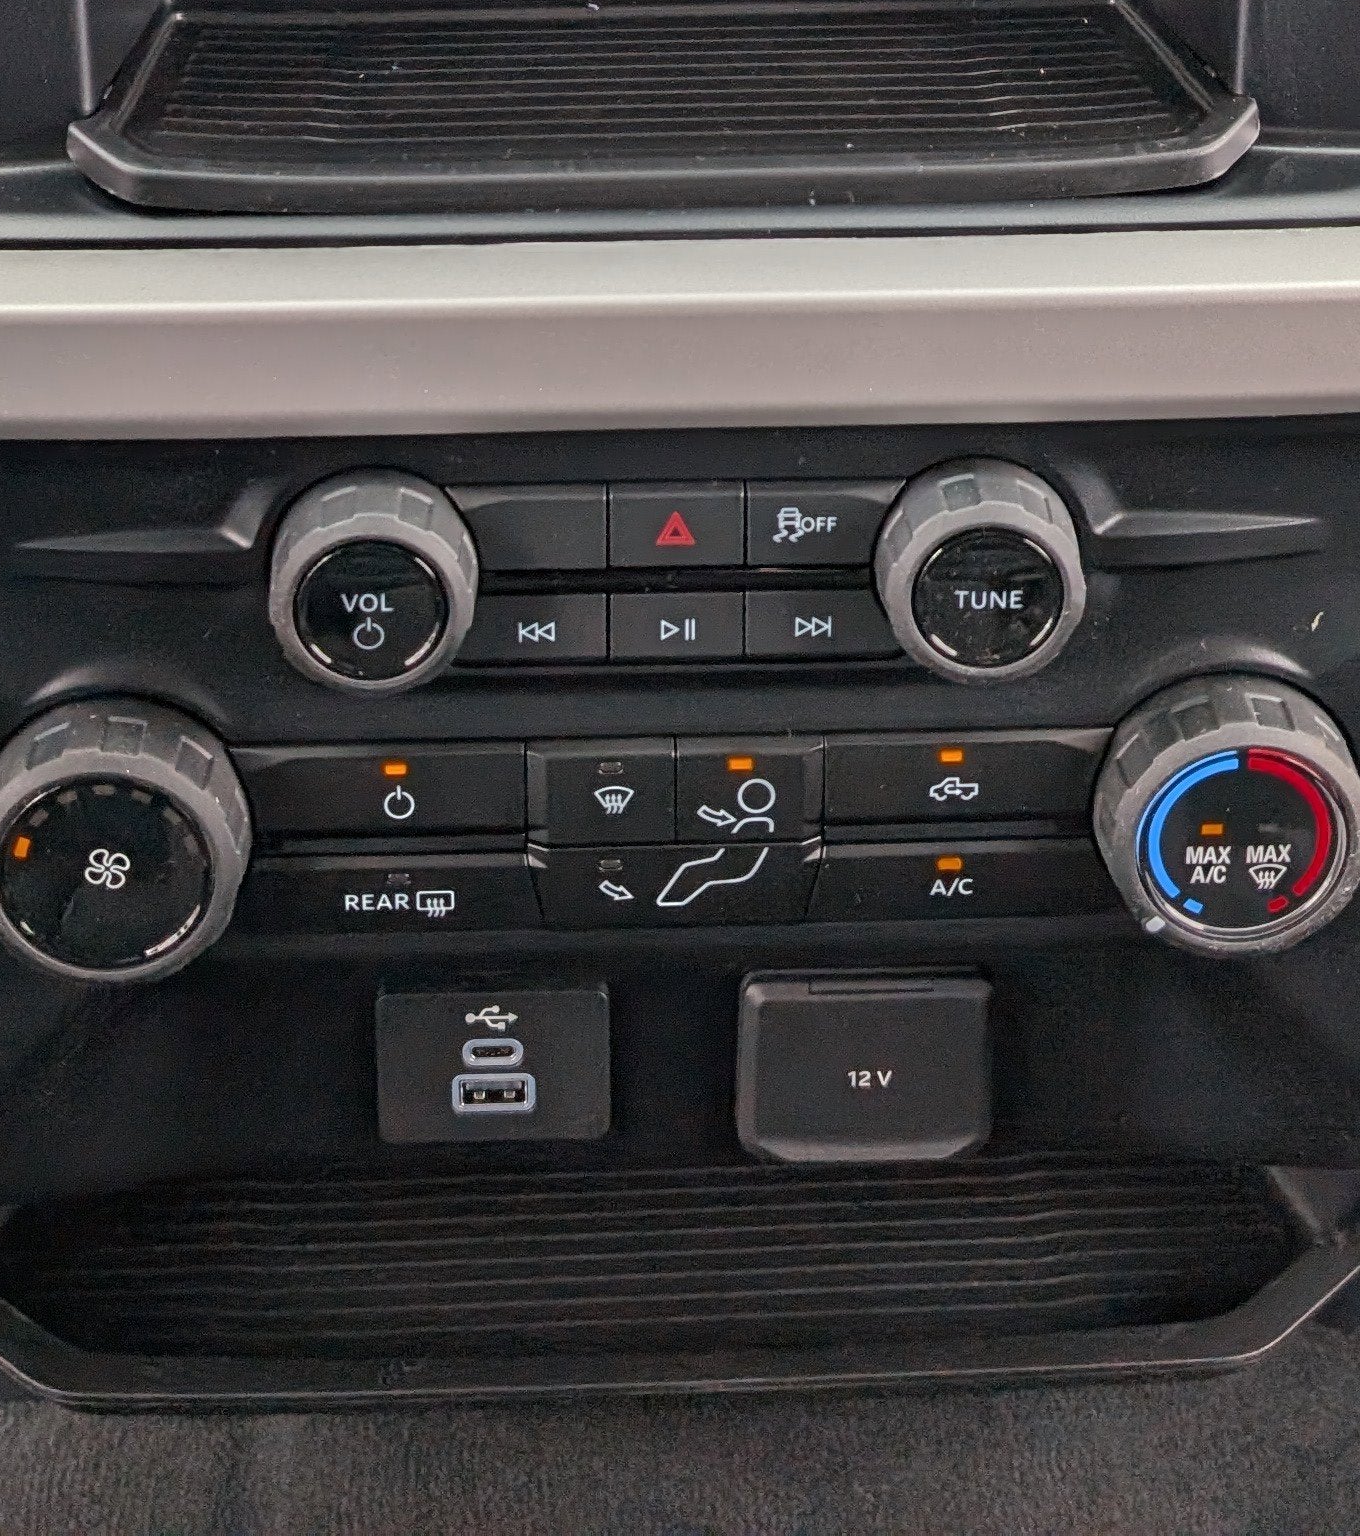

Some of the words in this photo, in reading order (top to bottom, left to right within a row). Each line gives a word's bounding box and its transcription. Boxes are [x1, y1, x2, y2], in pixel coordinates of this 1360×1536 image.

[801, 516, 837, 533] OFF
[341, 593, 394, 613] VOL
[954, 590, 1023, 610] TUNE
[1186, 846, 1231, 865] MAX
[1246, 844, 1291, 863] MAX
[1190, 866, 1227, 884] A/C
[929, 878, 973, 897] A/C
[344, 893, 410, 911] REAR
[847, 1070, 873, 1088] 12
[875, 1070, 893, 1088] V
